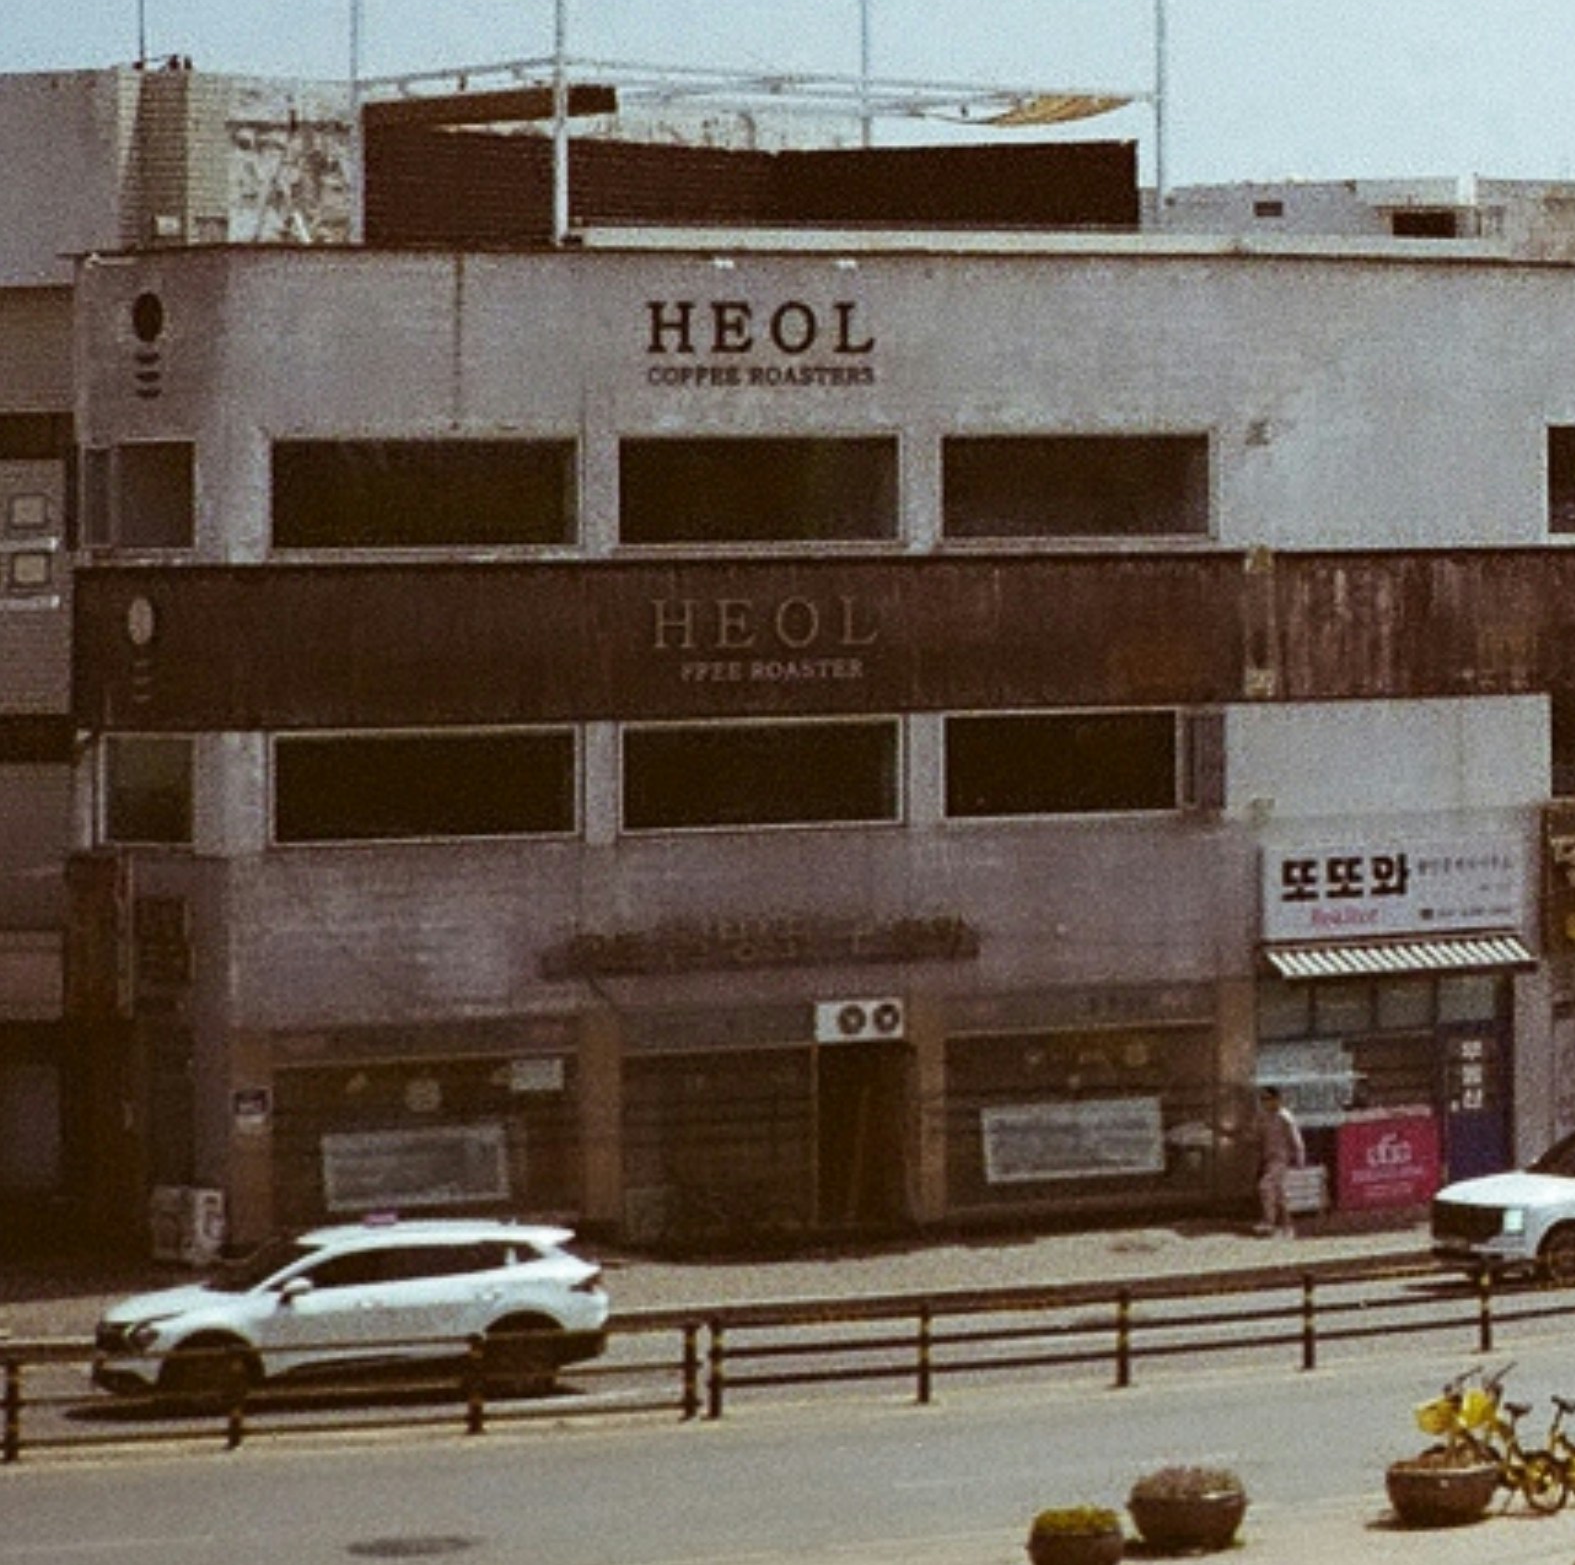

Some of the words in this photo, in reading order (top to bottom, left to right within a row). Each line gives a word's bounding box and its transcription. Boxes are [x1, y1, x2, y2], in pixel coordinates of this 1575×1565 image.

[647, 300, 875, 354] HEOL
[648, 366, 741, 386] COFFEE
[750, 366, 875, 386] ROASTERS
[652, 595, 878, 648] HEOL
[1281, 853, 1411, 903] 또또와
